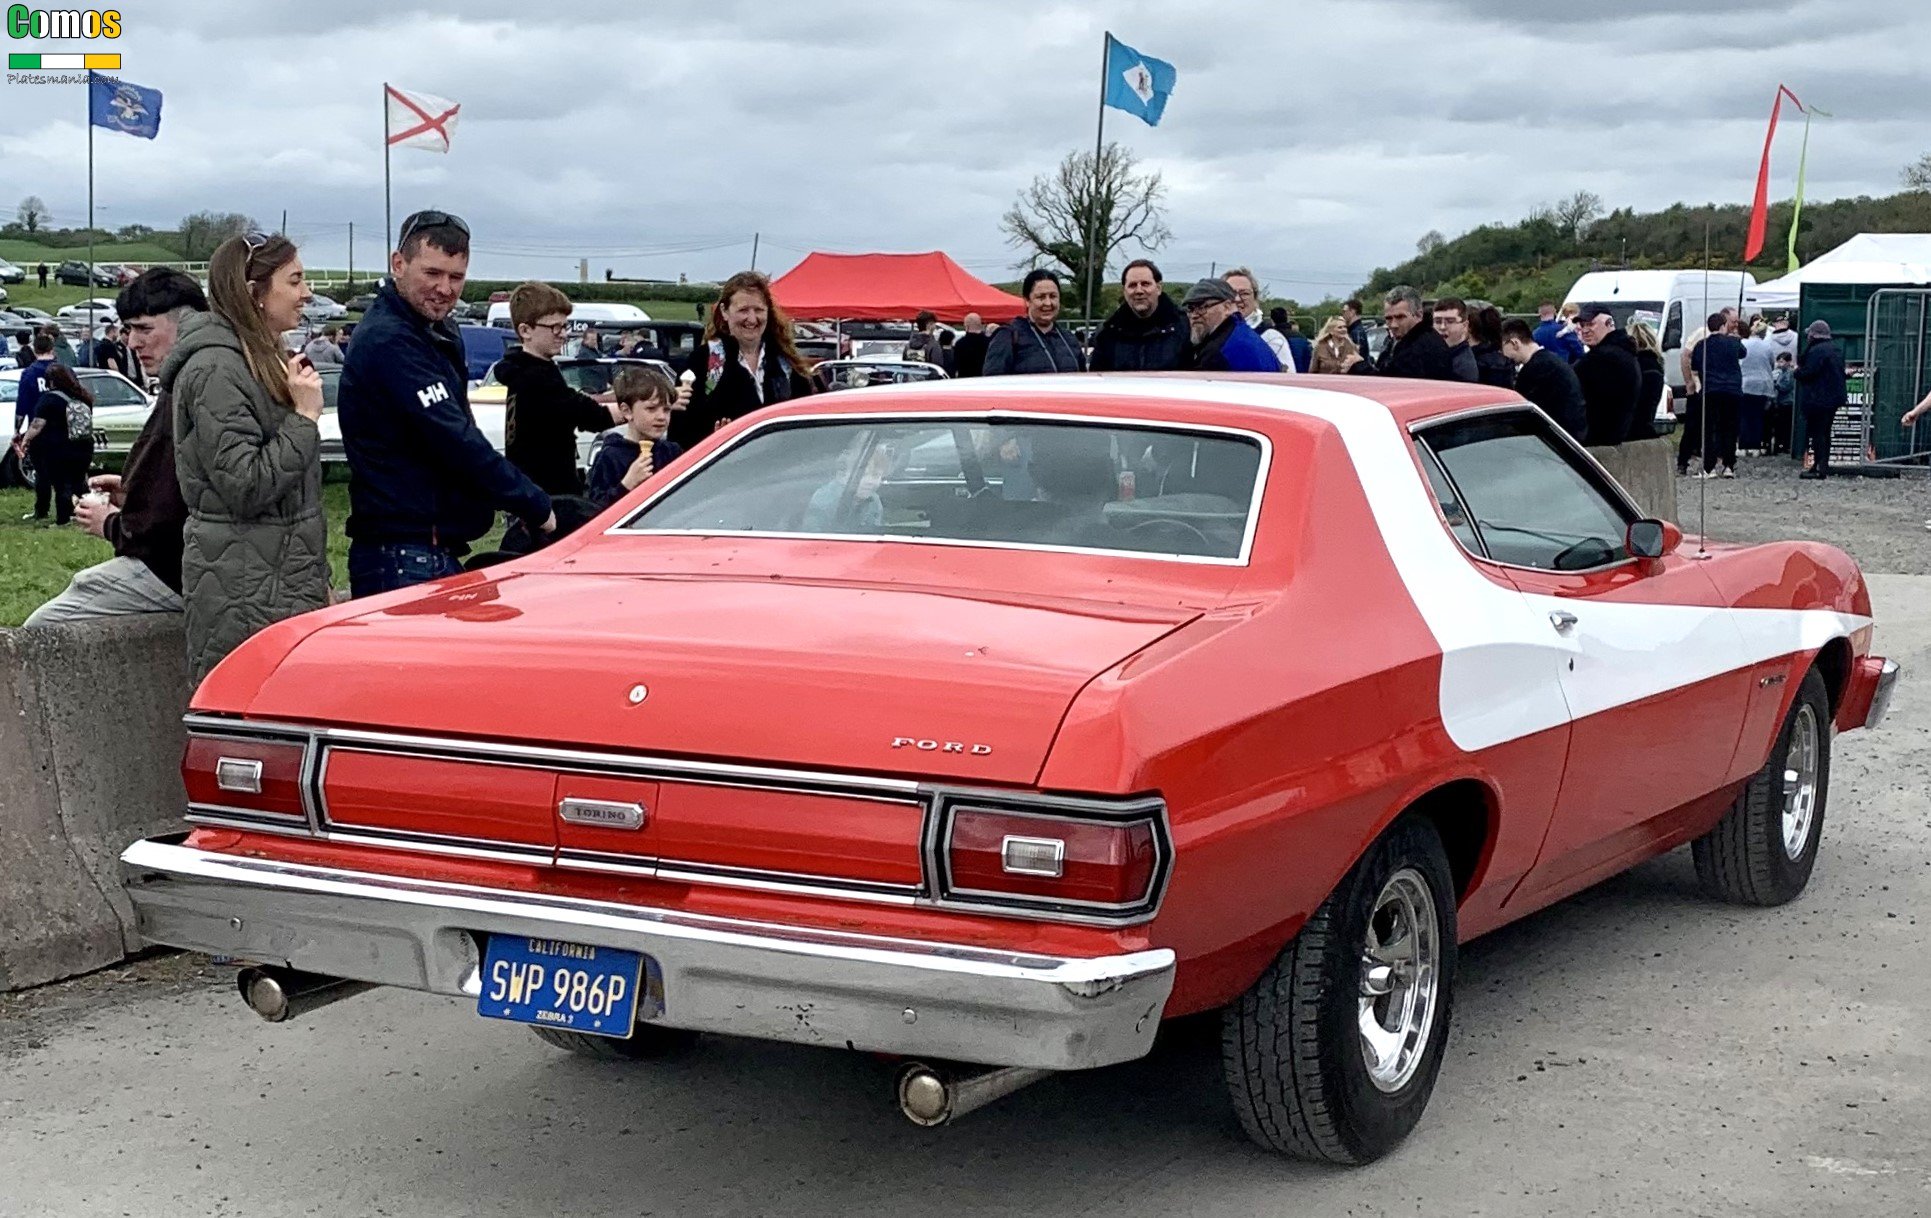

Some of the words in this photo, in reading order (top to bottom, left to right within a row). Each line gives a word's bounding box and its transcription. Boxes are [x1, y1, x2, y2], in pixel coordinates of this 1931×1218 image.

[416, 381, 449, 408] HH
[890, 737, 993, 756] FORD
[575, 807, 626, 820] TORINO
[528, 939, 596, 960] CALIFORNIA
[490, 960, 545, 1005] SWP
[553, 968, 626, 1017] 986P
[536, 1010, 566, 1023] ZEBRA
